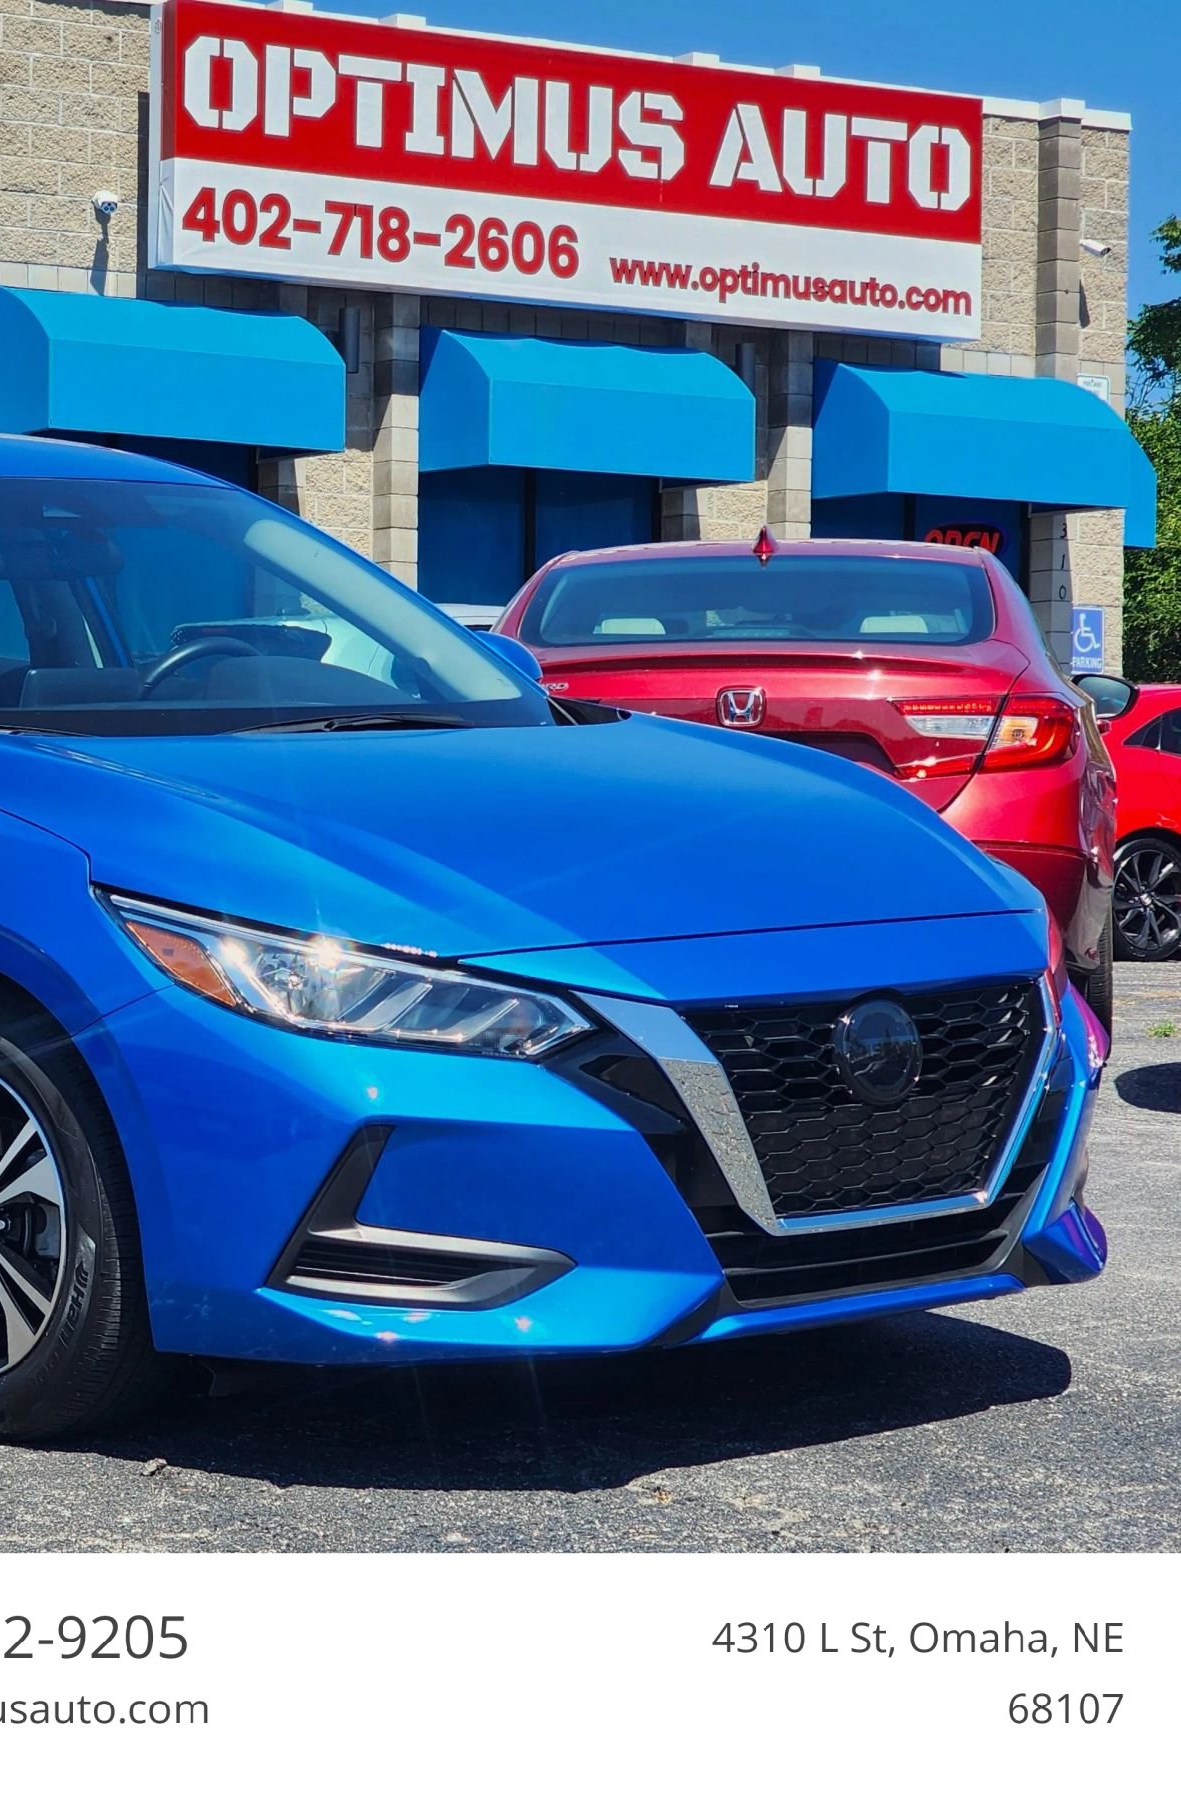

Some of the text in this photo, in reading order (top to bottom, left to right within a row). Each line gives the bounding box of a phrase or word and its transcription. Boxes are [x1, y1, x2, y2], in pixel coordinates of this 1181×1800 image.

[183, 35, 972, 212] OPTIMUS AUTO
[181, 186, 580, 279] 402-718-2606
[608, 257, 972, 316] www.optimusauto.com
[1072, 656, 1102, 669] PARKING
